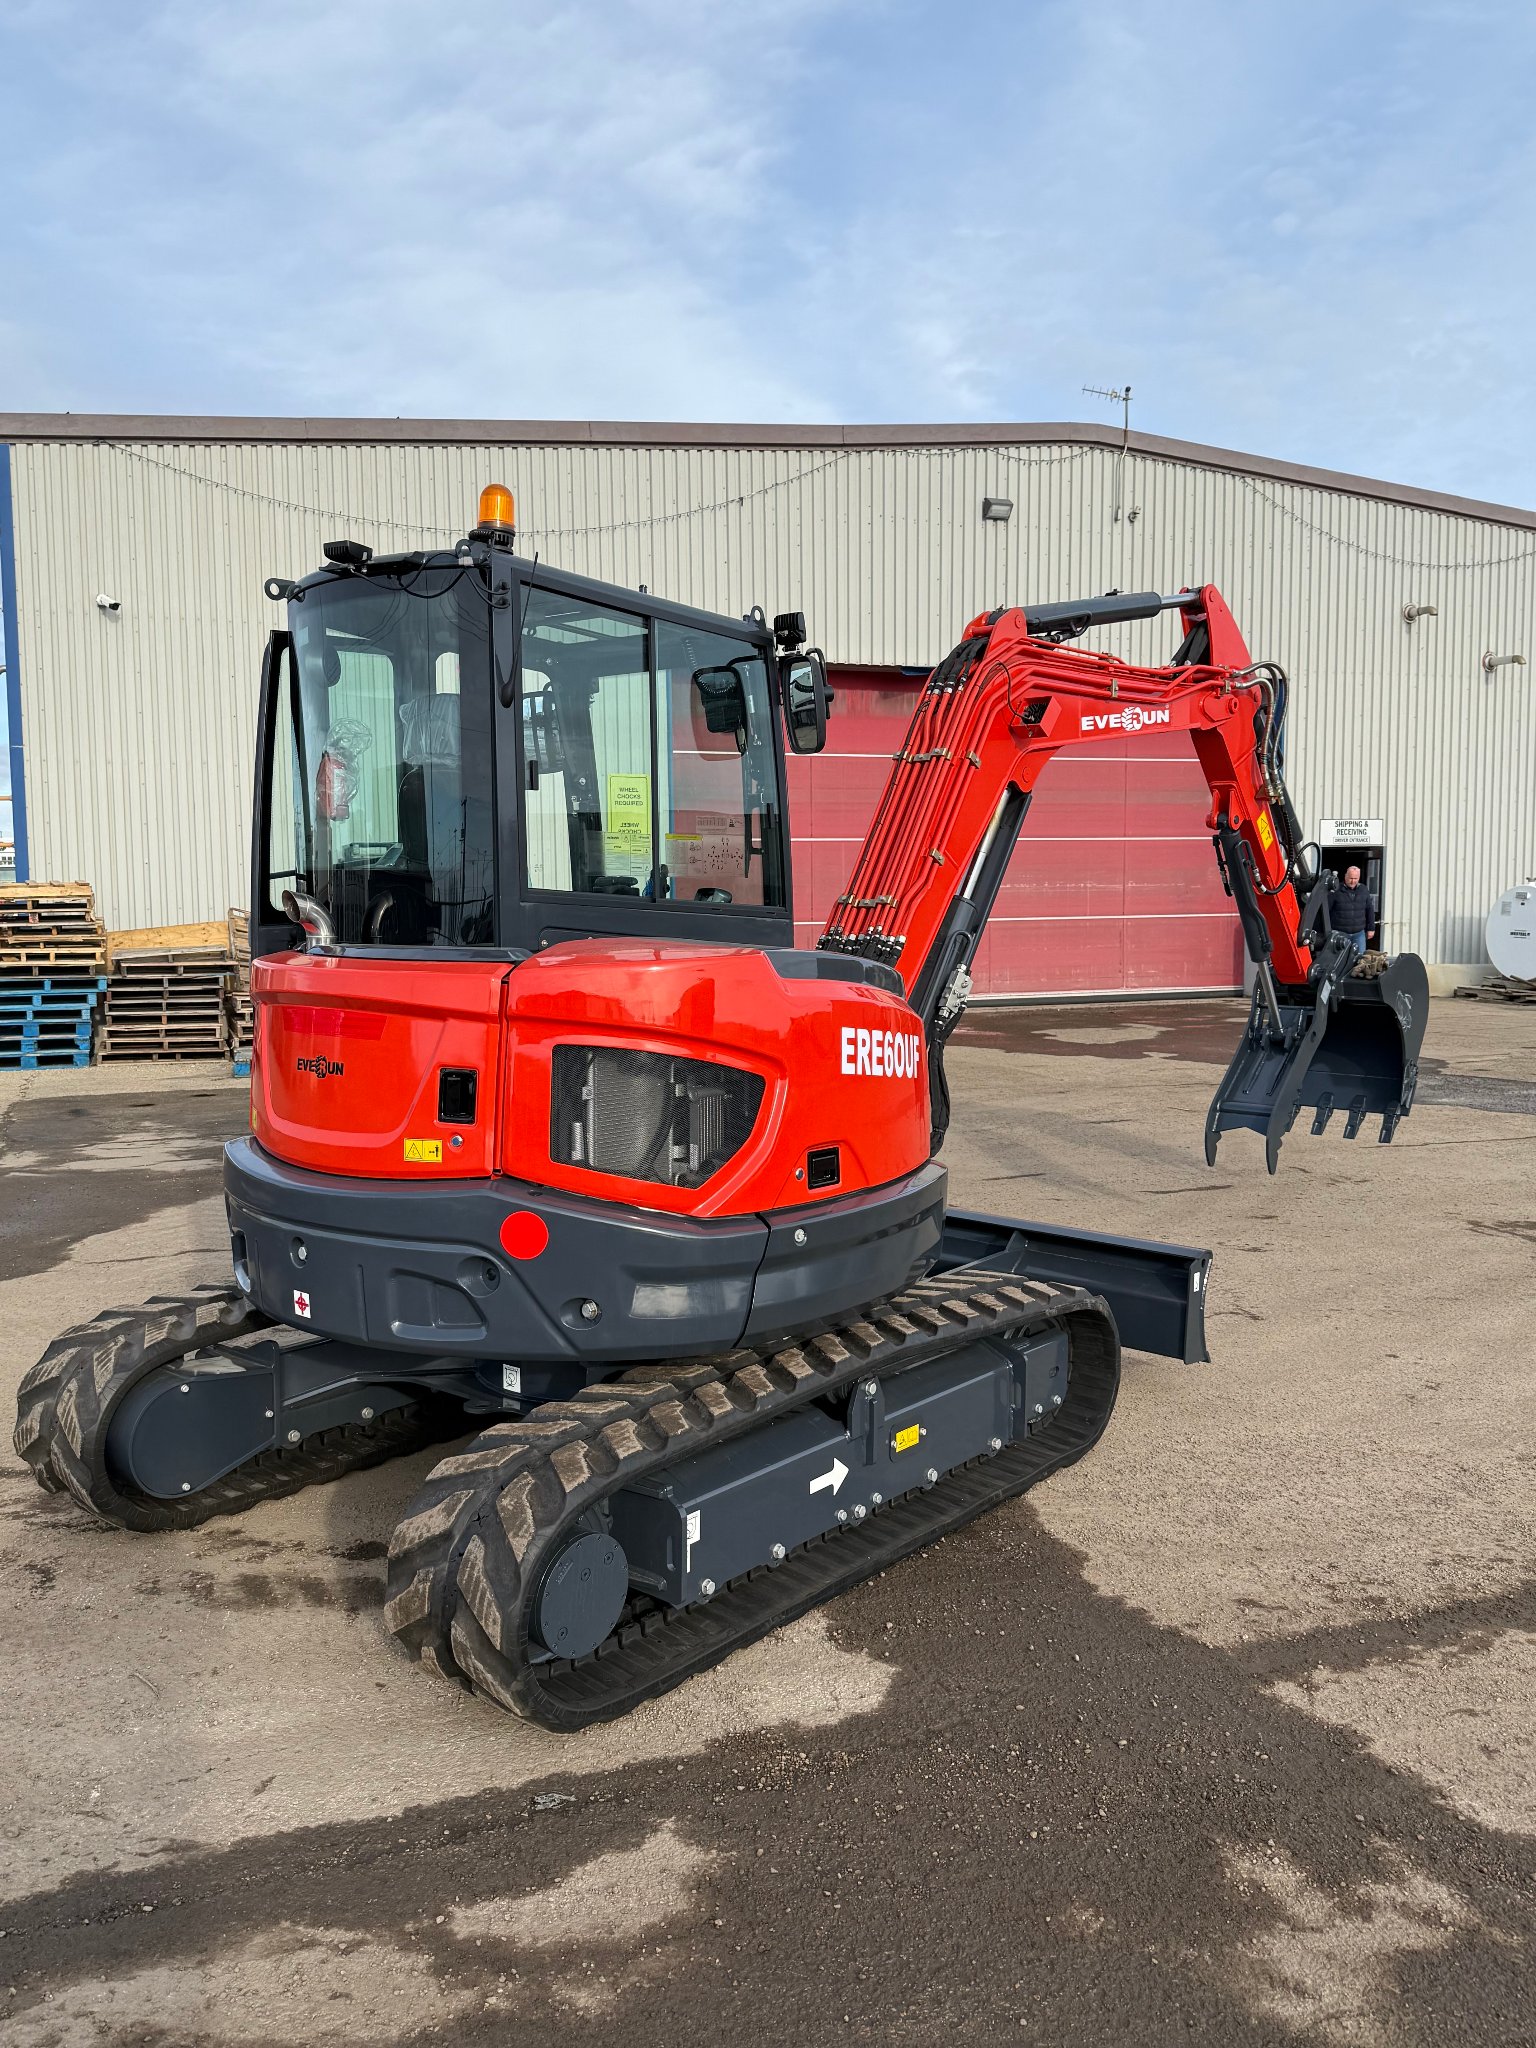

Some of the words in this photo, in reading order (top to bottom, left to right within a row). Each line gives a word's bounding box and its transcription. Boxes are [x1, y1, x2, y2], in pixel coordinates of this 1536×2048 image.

[1081, 706, 1170, 732] EVERUN
[1334, 820, 1363, 828] SHIPPING
[1364, 820, 1369, 828] &
[1336, 828, 1367, 836] RECEIVING
[841, 1026, 920, 1079] ERE60UF
[297, 1055, 345, 1078] EVERUN
